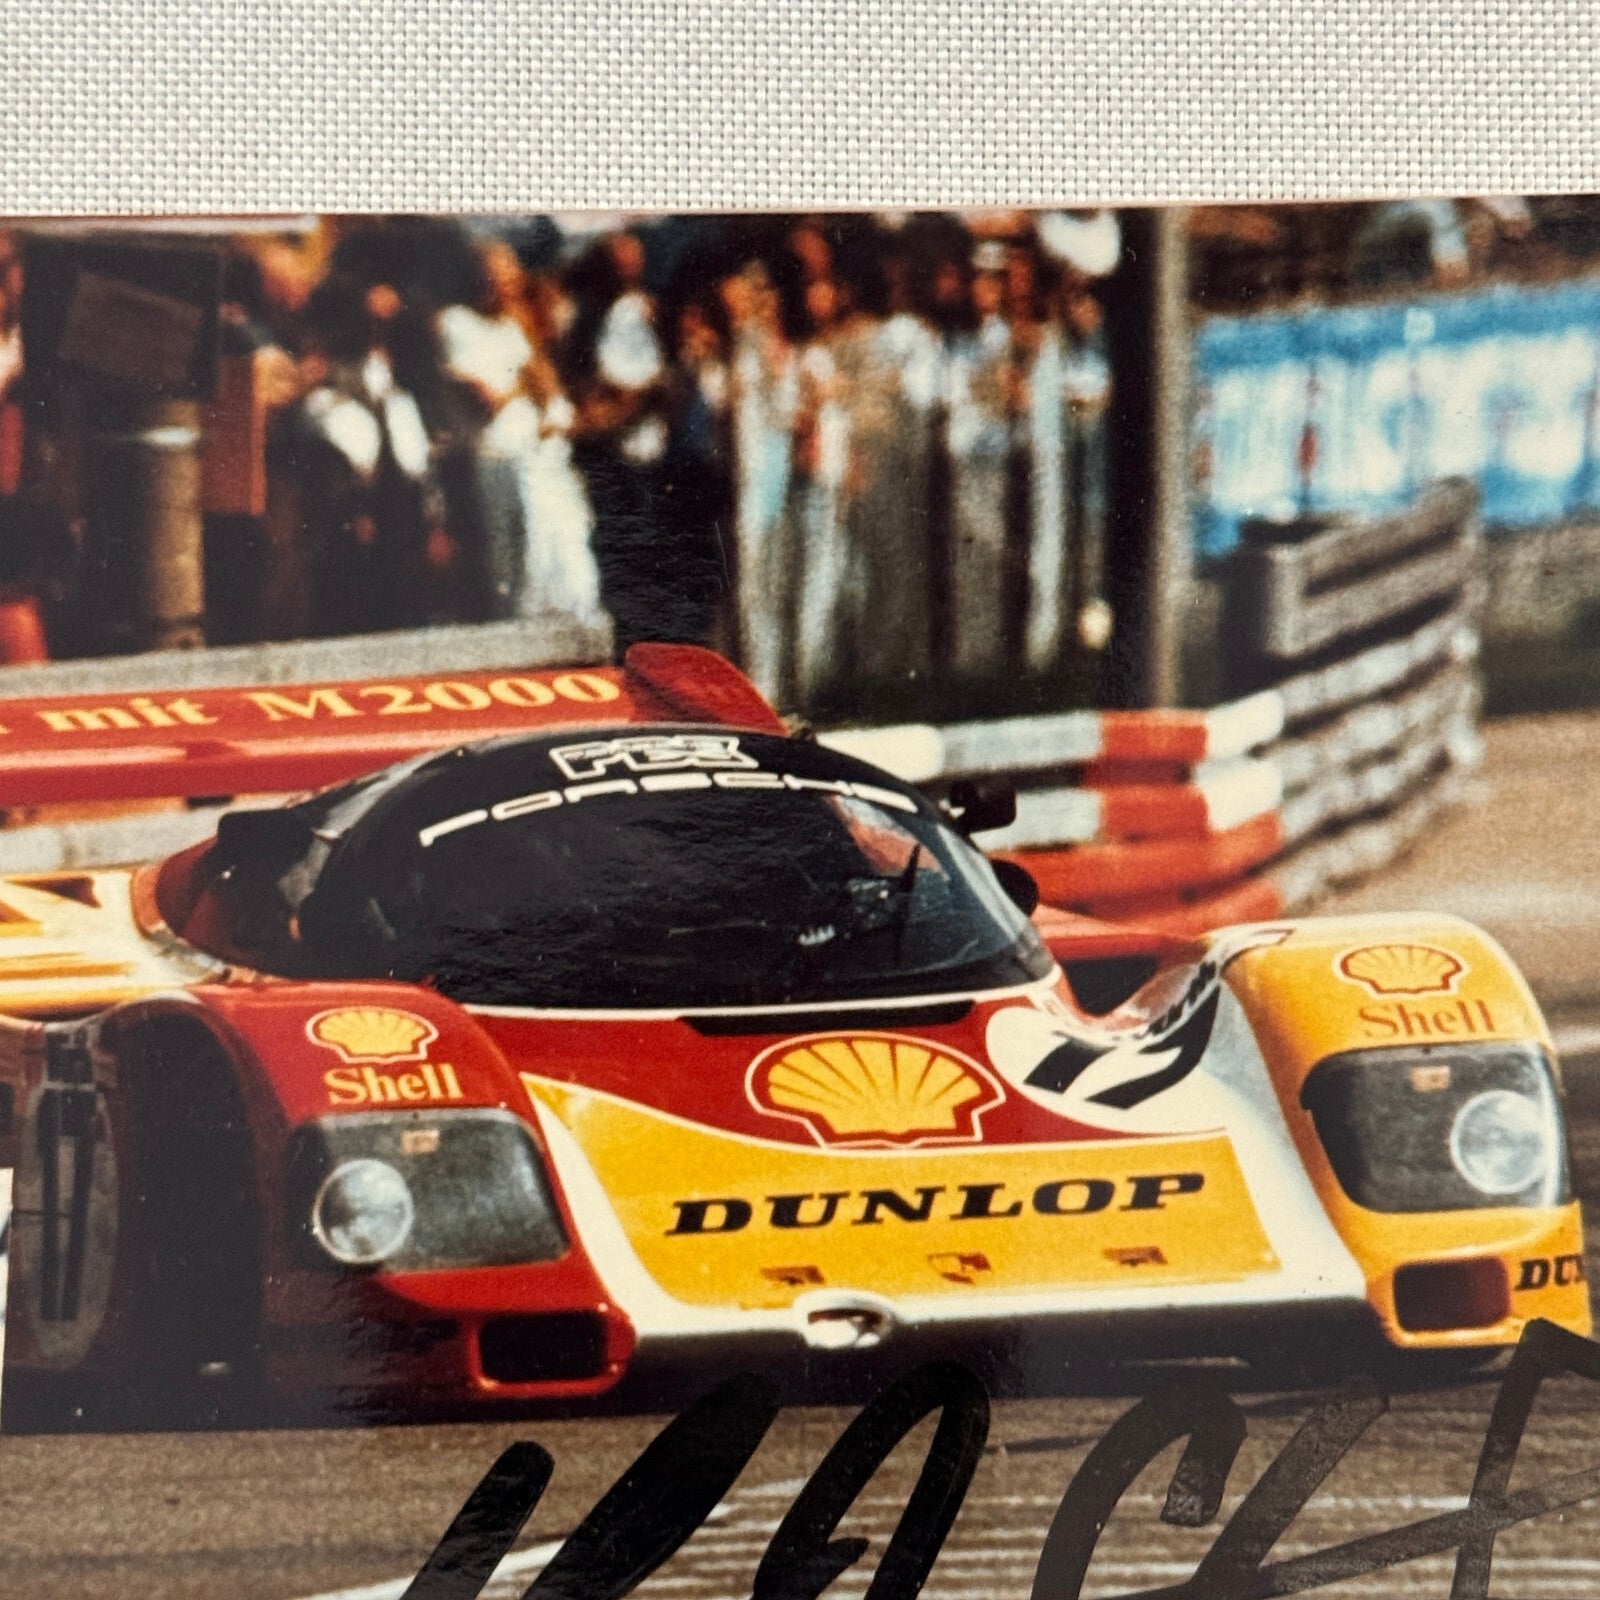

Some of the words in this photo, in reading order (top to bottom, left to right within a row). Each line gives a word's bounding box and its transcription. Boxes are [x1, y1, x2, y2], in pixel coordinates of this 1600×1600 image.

[36, 697, 220, 732] mit
[1357, 1000, 1498, 1038] Shell
[323, 1063, 465, 1105] Shell
[665, 1173, 1206, 1236] DUNLOP
